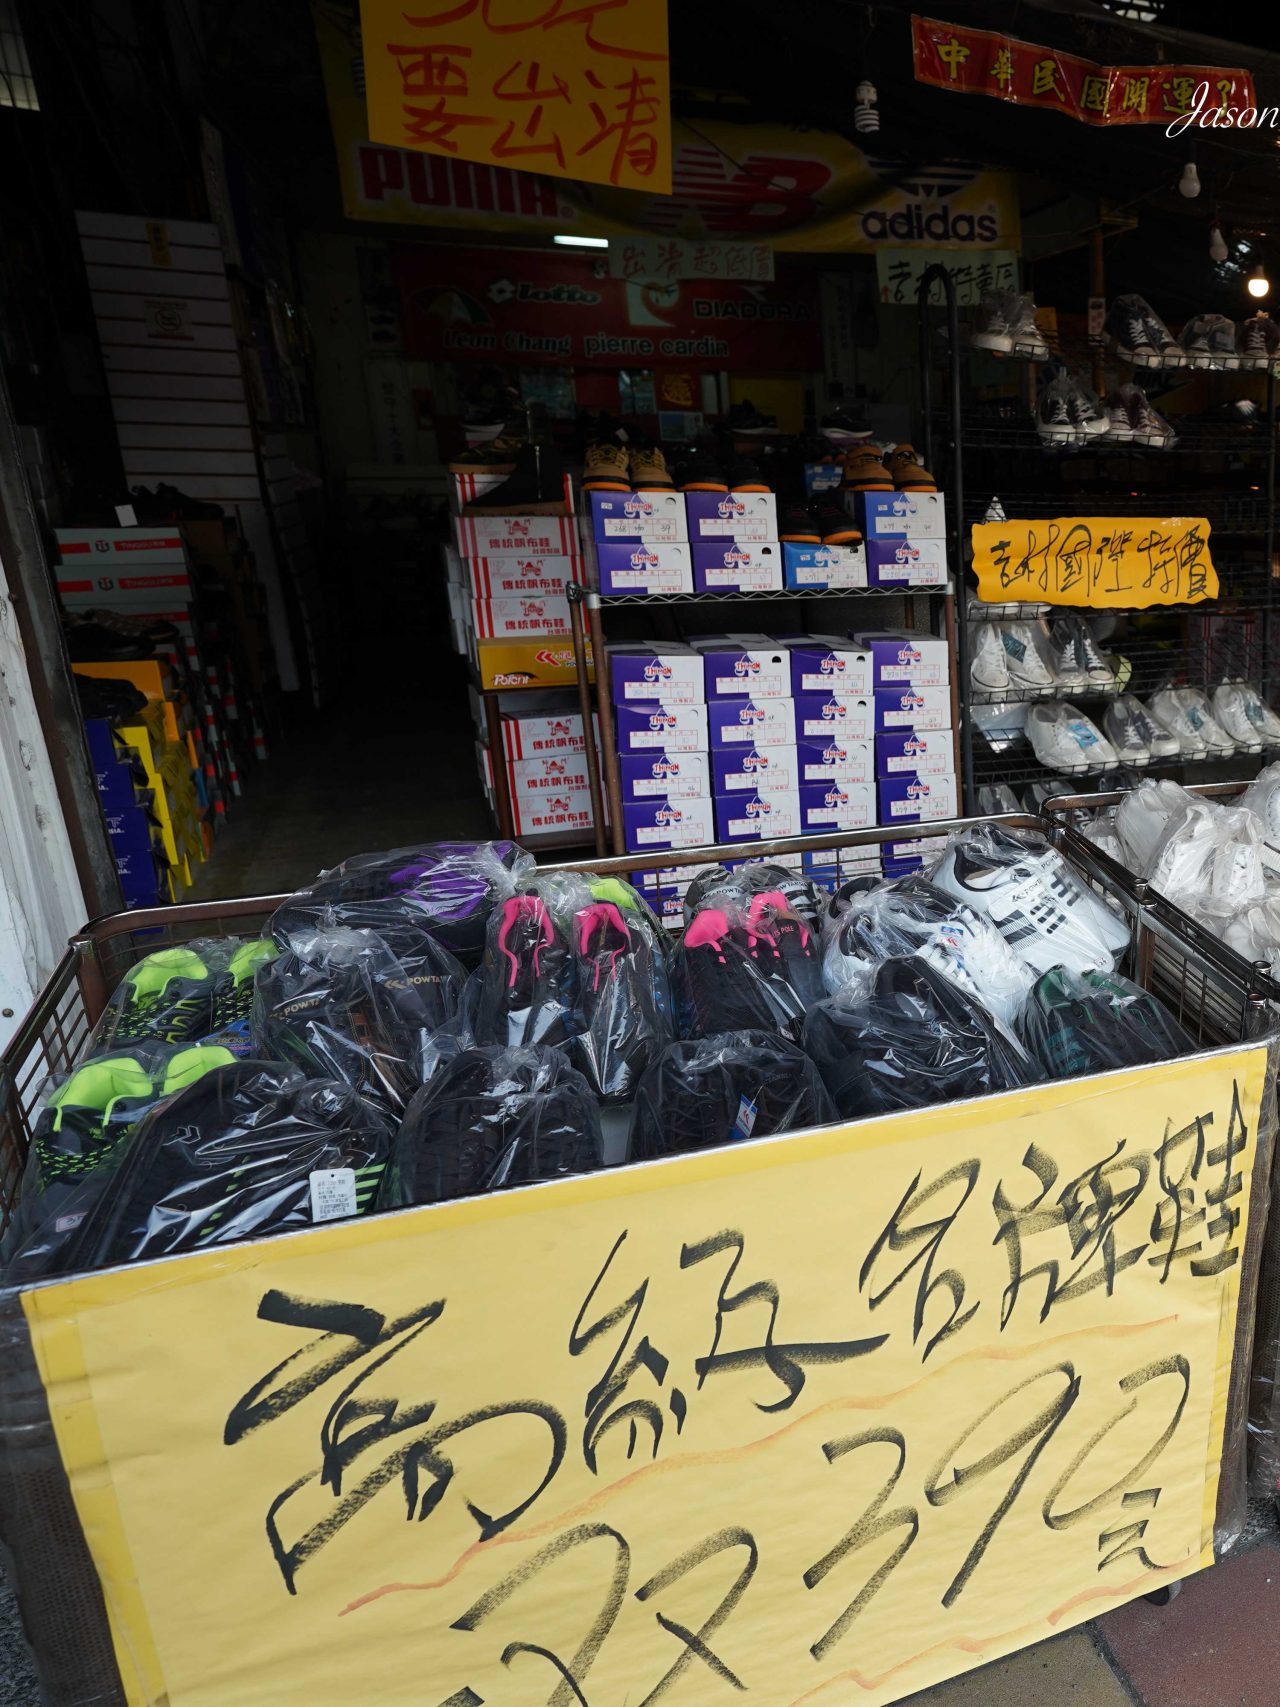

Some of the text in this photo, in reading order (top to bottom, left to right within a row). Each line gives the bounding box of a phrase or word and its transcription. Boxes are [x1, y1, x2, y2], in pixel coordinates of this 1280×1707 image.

[386, 43, 662, 184] 要出清
[861, 204, 998, 242] adidas
[584, 332, 730, 358] pierre cardin
